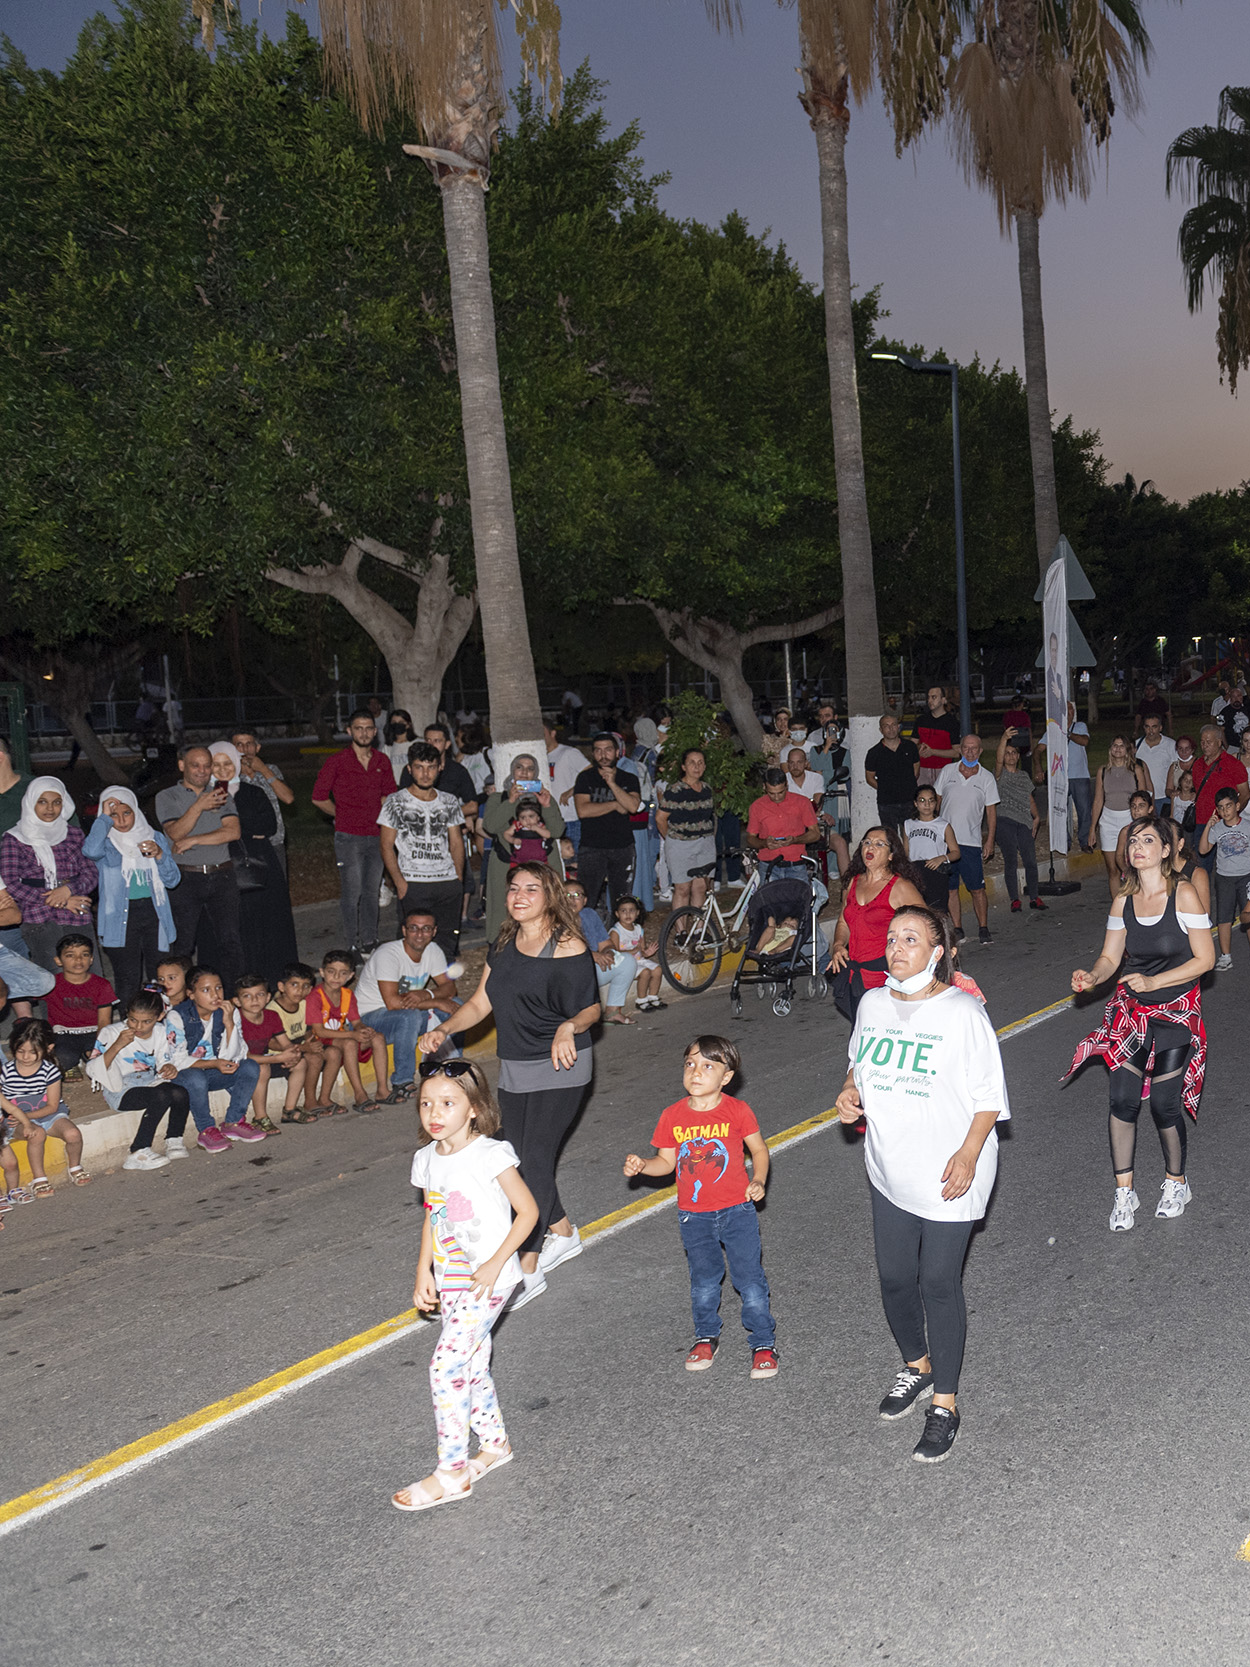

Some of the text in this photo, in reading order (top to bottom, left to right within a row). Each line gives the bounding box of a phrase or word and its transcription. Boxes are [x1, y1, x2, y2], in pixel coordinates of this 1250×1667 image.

[885, 1028, 903, 1036] YOUR
[915, 1032, 943, 1041] VEGGIES
[856, 1035, 937, 1075] VOTE.
[873, 1083, 893, 1092] YOUR
[672, 1123, 730, 1144] BATMAN
